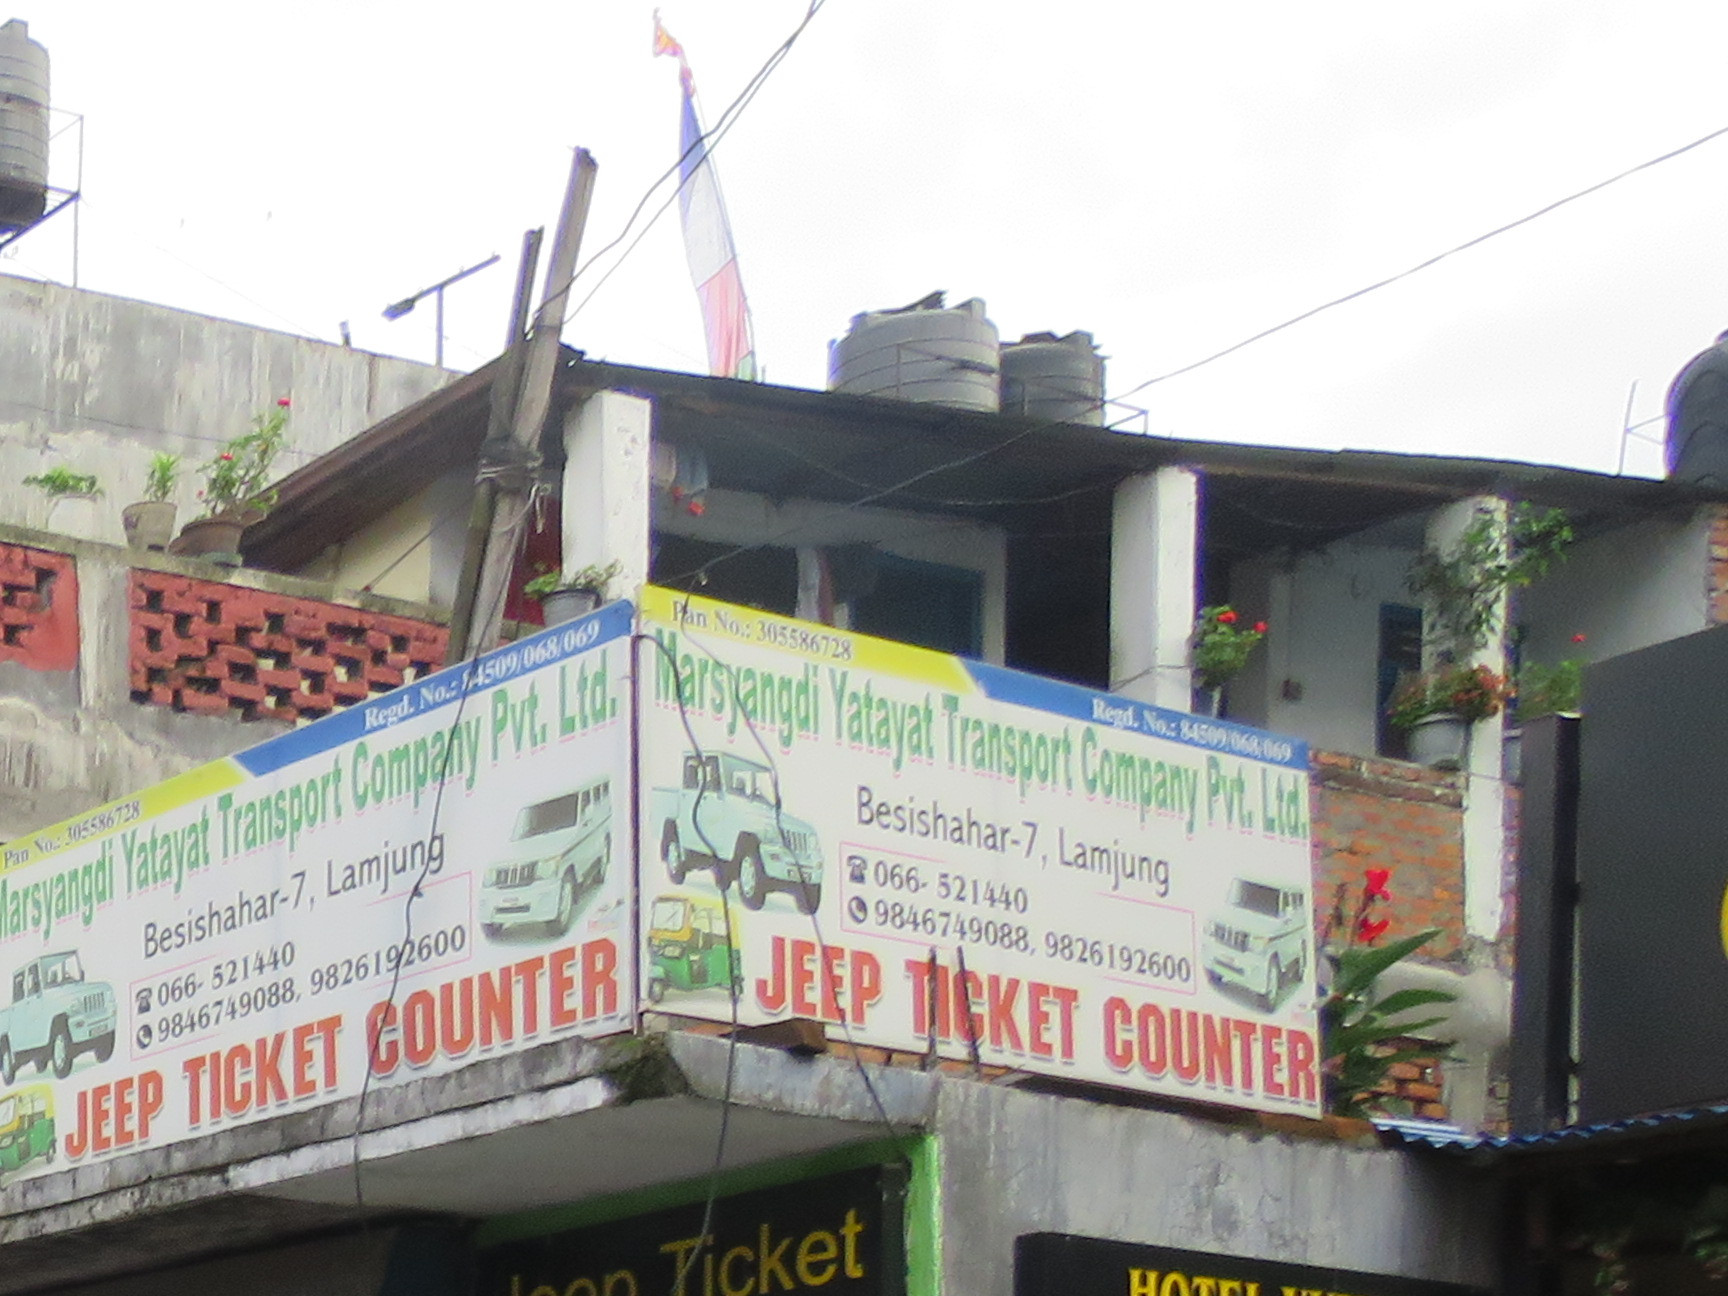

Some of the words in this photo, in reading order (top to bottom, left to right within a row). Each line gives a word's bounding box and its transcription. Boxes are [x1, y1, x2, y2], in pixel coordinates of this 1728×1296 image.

[672, 601, 708, 628] Pan
[714, 612, 752, 639] No.:
[757, 620, 852, 661] 305586728
[364, 694, 415, 730] Regd.
[655, 626, 820, 747] Marsyangdi
[829, 670, 933, 771] Yatayat
[940, 691, 1072, 803] Transport
[1081, 725, 1197, 832] Company
[1206, 755, 1253, 826] Pvt.
[1260, 766, 1307, 839] Ltd.
[1092, 698, 1138, 730] Regd.
[122, 814, 210, 892] Yatayat
[217, 769, 343, 862] Transport
[351, 712, 481, 812] Company
[490, 685, 548, 764] Pvt.
[558, 649, 617, 738] Ltd.
[3, 845, 29, 869] Pan
[64, 802, 141, 847] 305586728
[857, 785, 1048, 870] Besishahar-7,
[1060, 826, 1171, 898] Lamjung
[143, 871, 317, 960] Besishahar-7,
[327, 832, 445, 898] Lamjung
[873, 858, 927, 889] 066-
[938, 873, 1029, 915] 521440
[157, 966, 204, 1008] 066-
[212, 941, 296, 989] 521440
[157, 982, 302, 1043] 9846749088,
[310, 925, 466, 995] 9826192600
[874, 899, 1036, 955] 9846749088,
[1045, 931, 1191, 982] 9826192600
[65, 1068, 163, 1161] JEEP
[183, 1014, 344, 1129] TICKET
[366, 937, 619, 1078] COUNTER
[755, 935, 882, 1026] JEEP
[905, 955, 1080, 1061] TICKET
[1103, 995, 1317, 1101] COUNTER
